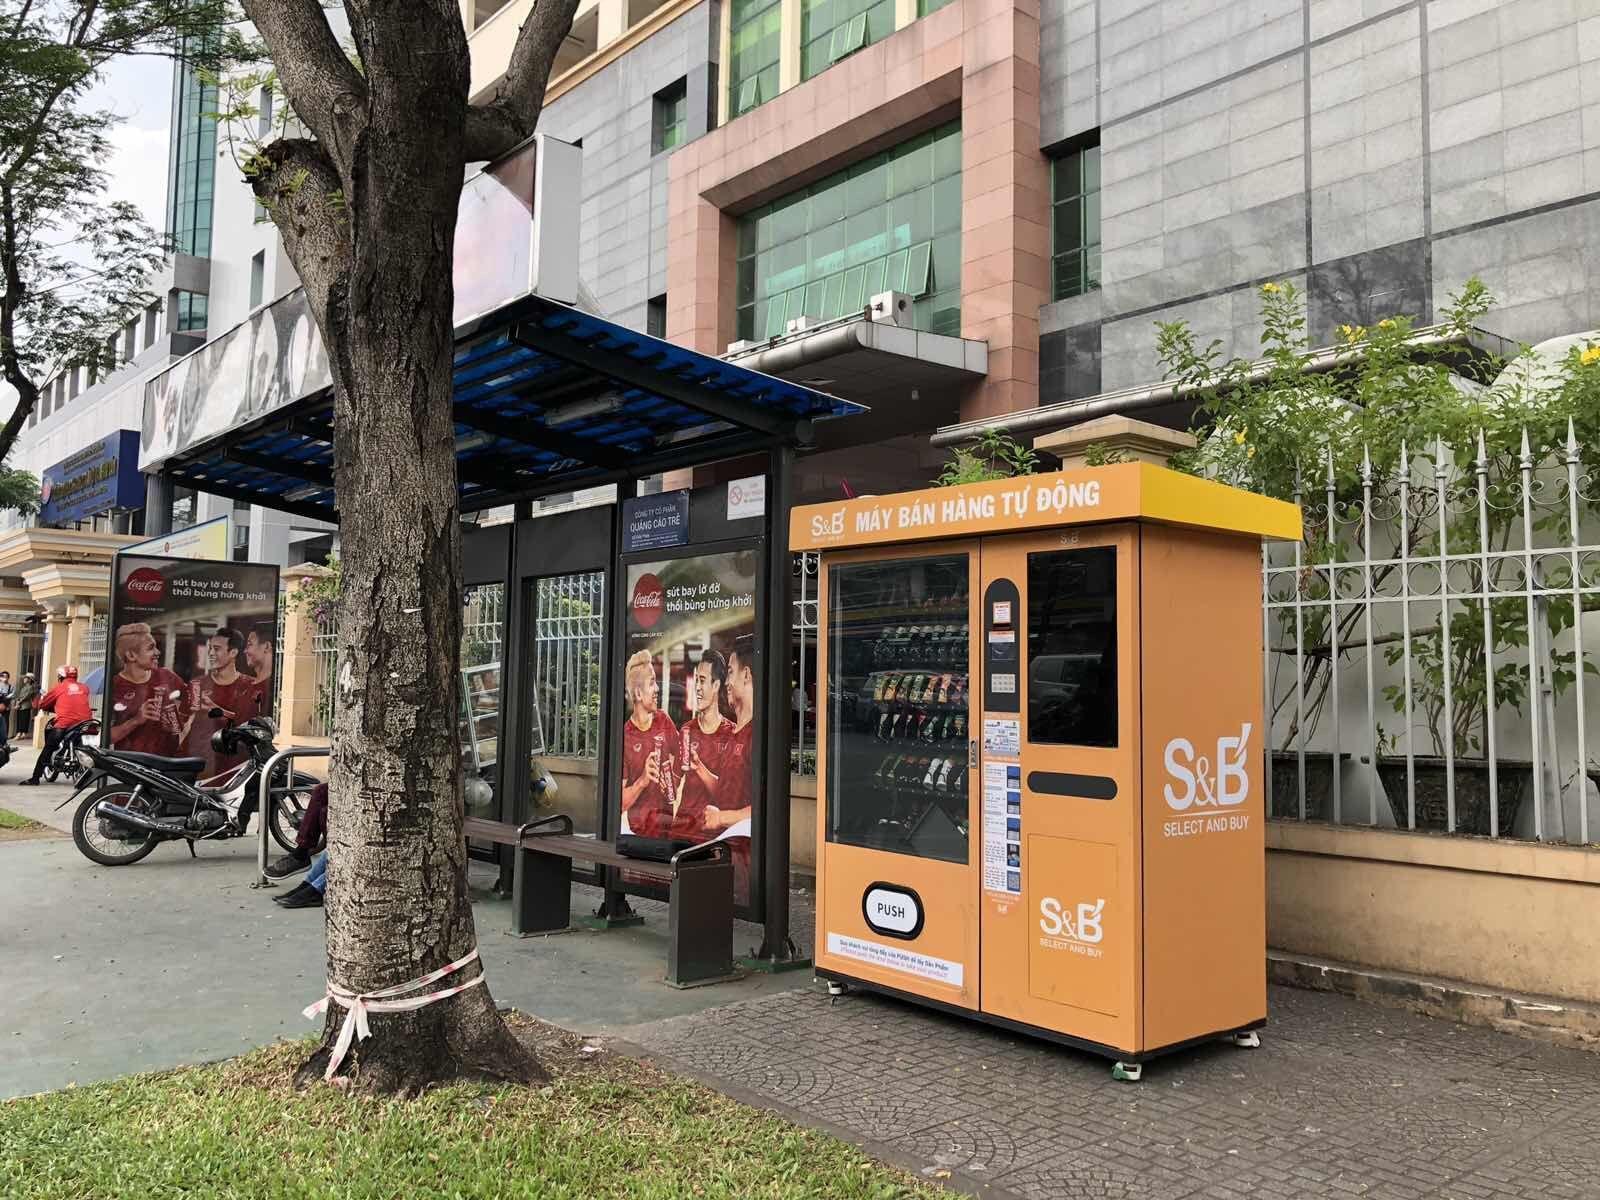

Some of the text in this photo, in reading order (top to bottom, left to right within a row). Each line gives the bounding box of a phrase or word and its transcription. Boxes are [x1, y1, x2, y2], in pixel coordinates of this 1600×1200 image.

[856, 505, 892, 533] MÁY
[899, 499, 936, 528] BÁN
[942, 494, 995, 523] HÀNG
[1001, 485, 1031, 519] TỰ
[1037, 479, 1100, 515] ĐỘNG
[191, 579, 208, 589] bay
[666, 582, 720, 598] sút bay lờ đờ
[666, 599, 683, 612] thổi
[684, 599, 706, 612] bùng
[732, 593, 752, 608] khởi
[1163, 722, 1253, 811] S&B
[1164, 815, 1249, 837] SELECT AND BUY
[877, 902, 905, 919] PUSH
[1039, 896, 1105, 944] S&B
[1039, 937, 1104, 958] SELECT AND BUY
